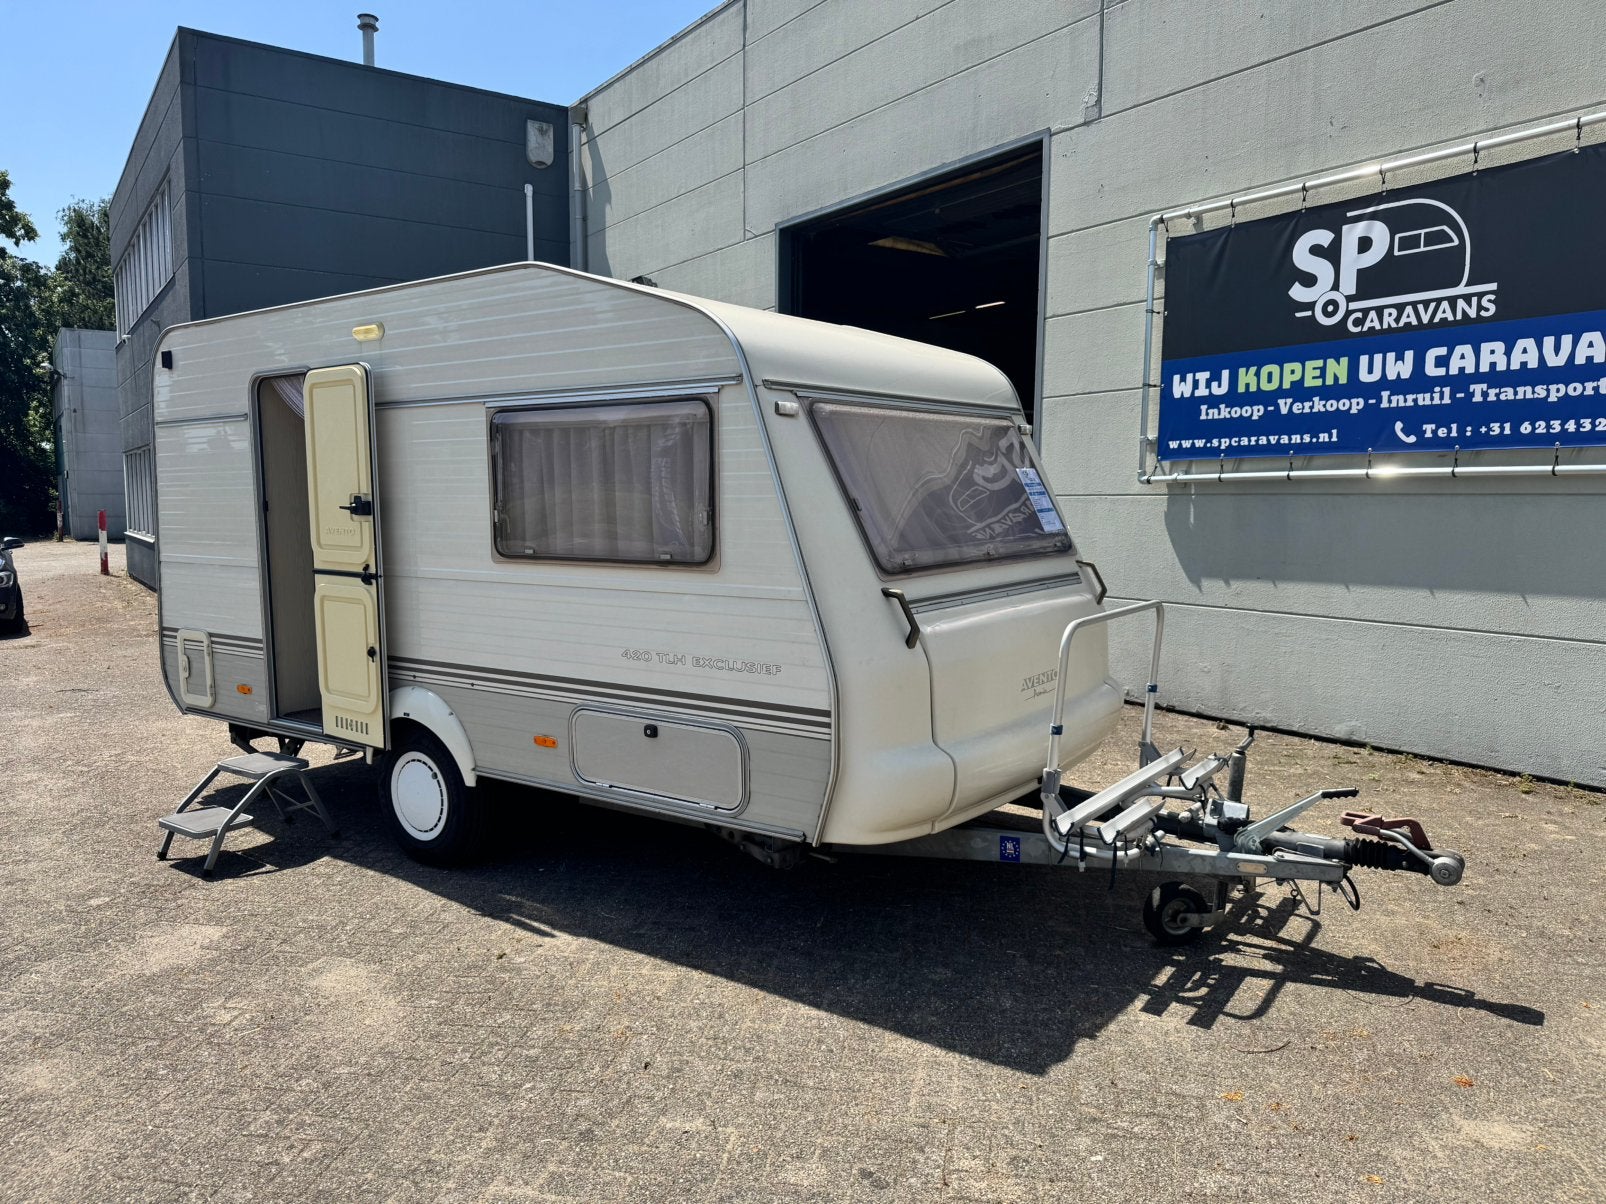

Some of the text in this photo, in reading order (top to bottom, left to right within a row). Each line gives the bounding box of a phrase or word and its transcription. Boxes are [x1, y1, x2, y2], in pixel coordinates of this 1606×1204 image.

[1288, 220, 1391, 302] SP
[1347, 294, 1497, 333] CARAVANS
[1172, 331, 1606, 398] WIJ KOPEN UW CARAVA
[1199, 403, 1265, 420] Inkoop
[1277, 396, 1365, 415] Verkoop
[1380, 386, 1451, 409] Inruil
[1168, 429, 1338, 450] www.spcaravans.nl
[1422, 423, 1458, 438] Tel
[1479, 422, 1512, 436] +31
[621, 649, 782, 676] 420 TLH EXCLUSIEF
